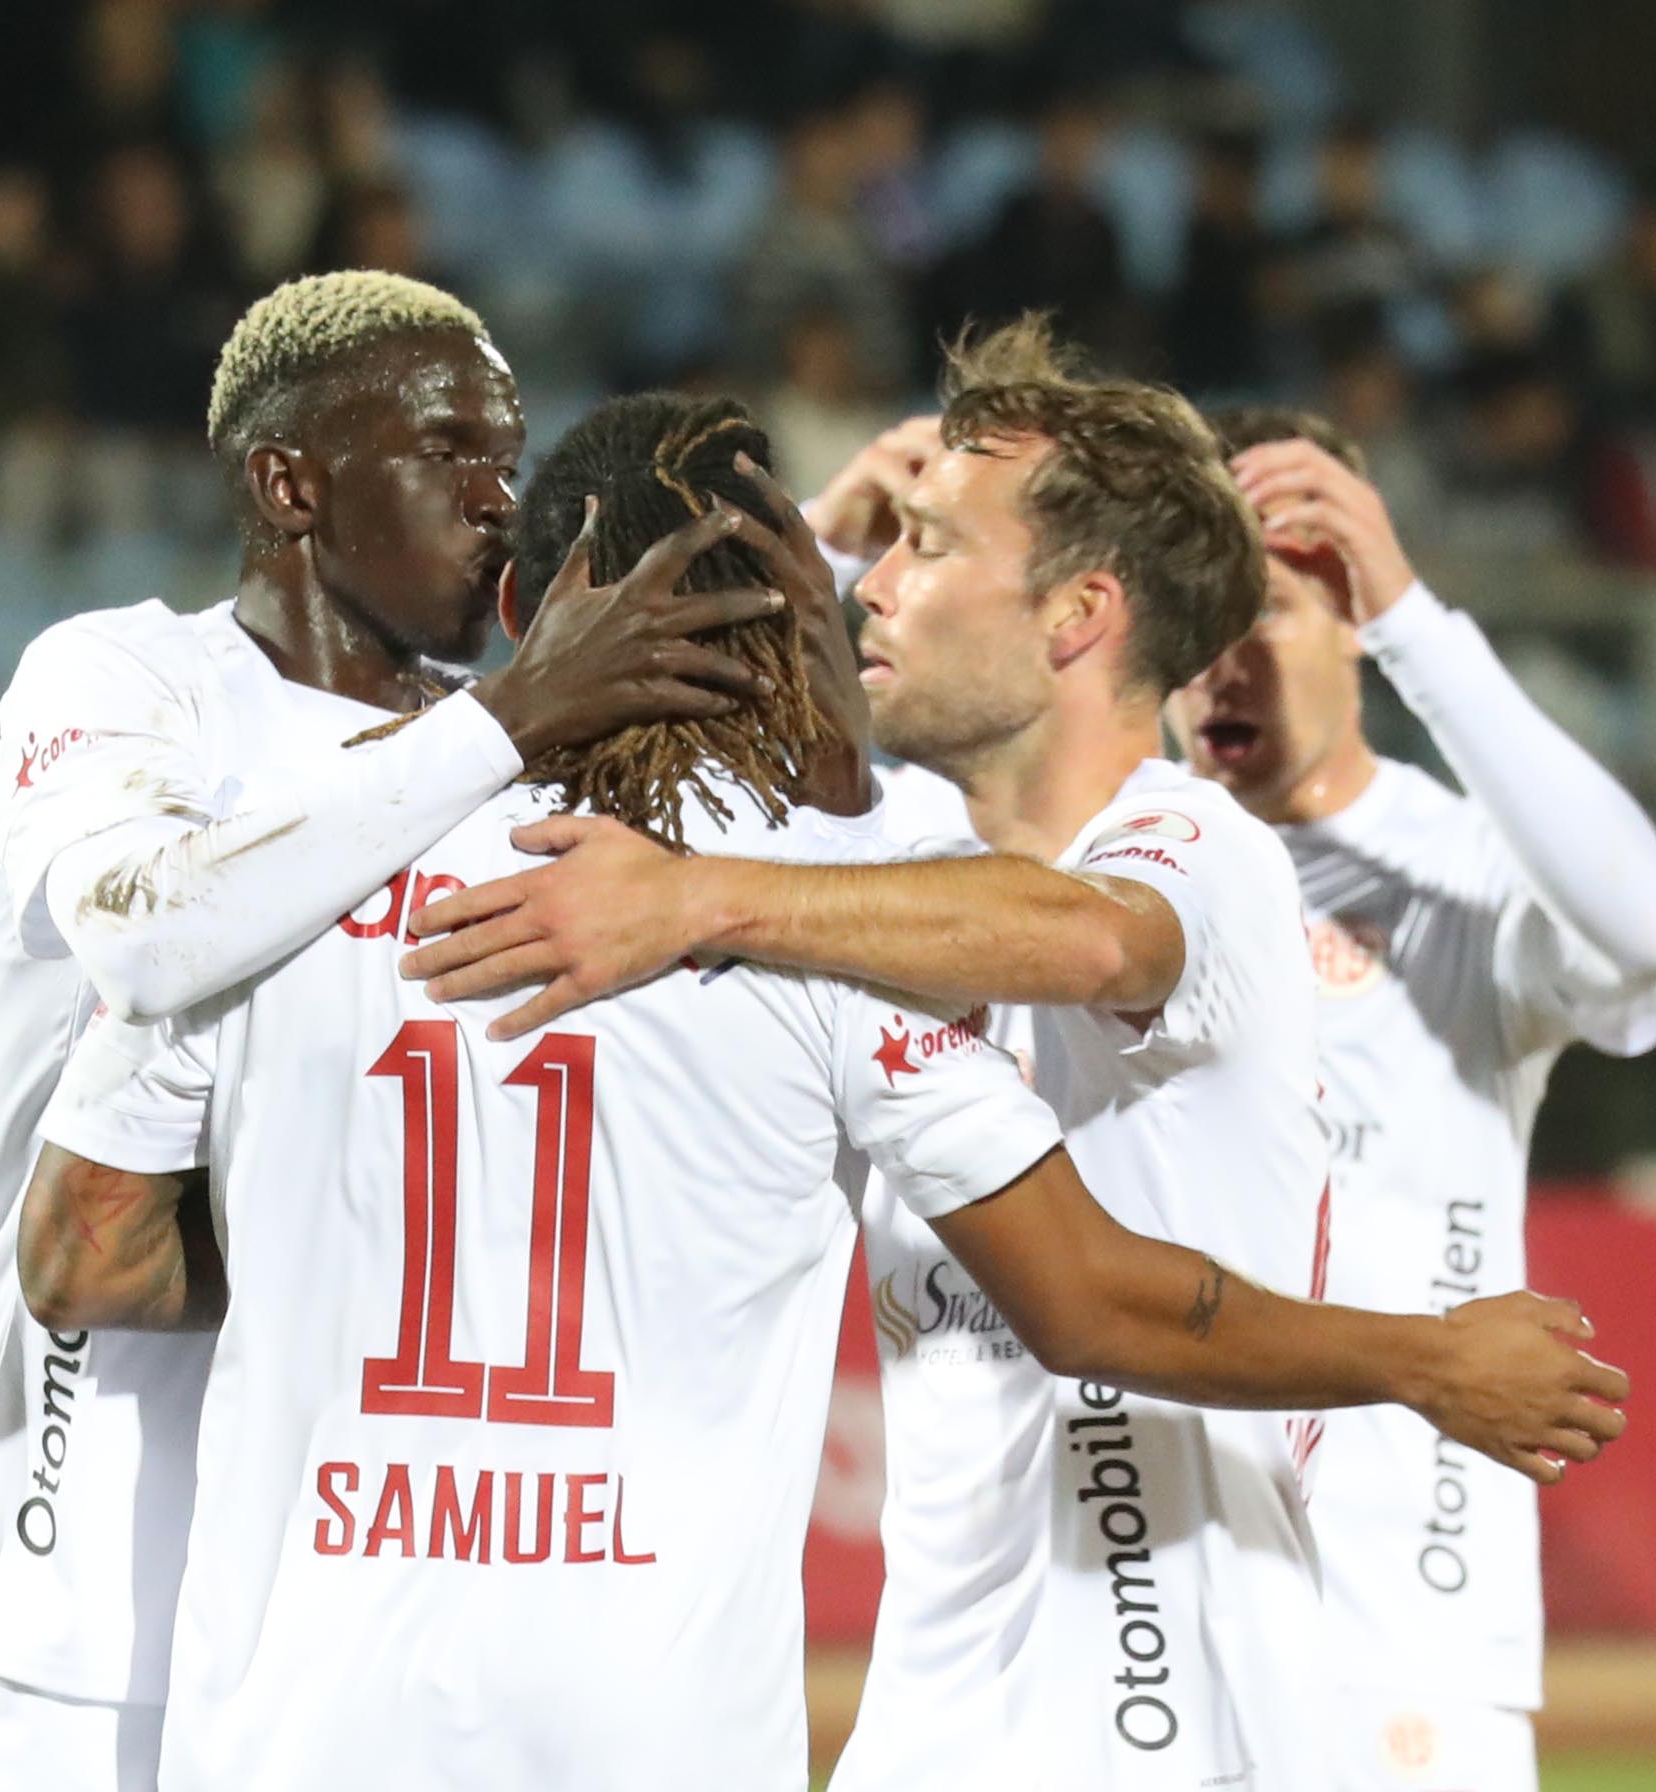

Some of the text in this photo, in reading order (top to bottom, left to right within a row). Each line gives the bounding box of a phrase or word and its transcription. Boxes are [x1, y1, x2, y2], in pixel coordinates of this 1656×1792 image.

[359, 1019, 616, 1429] 11
[313, 1461, 657, 1565] SAMUEL
[1067, 1379, 1179, 1752] Otomobile
